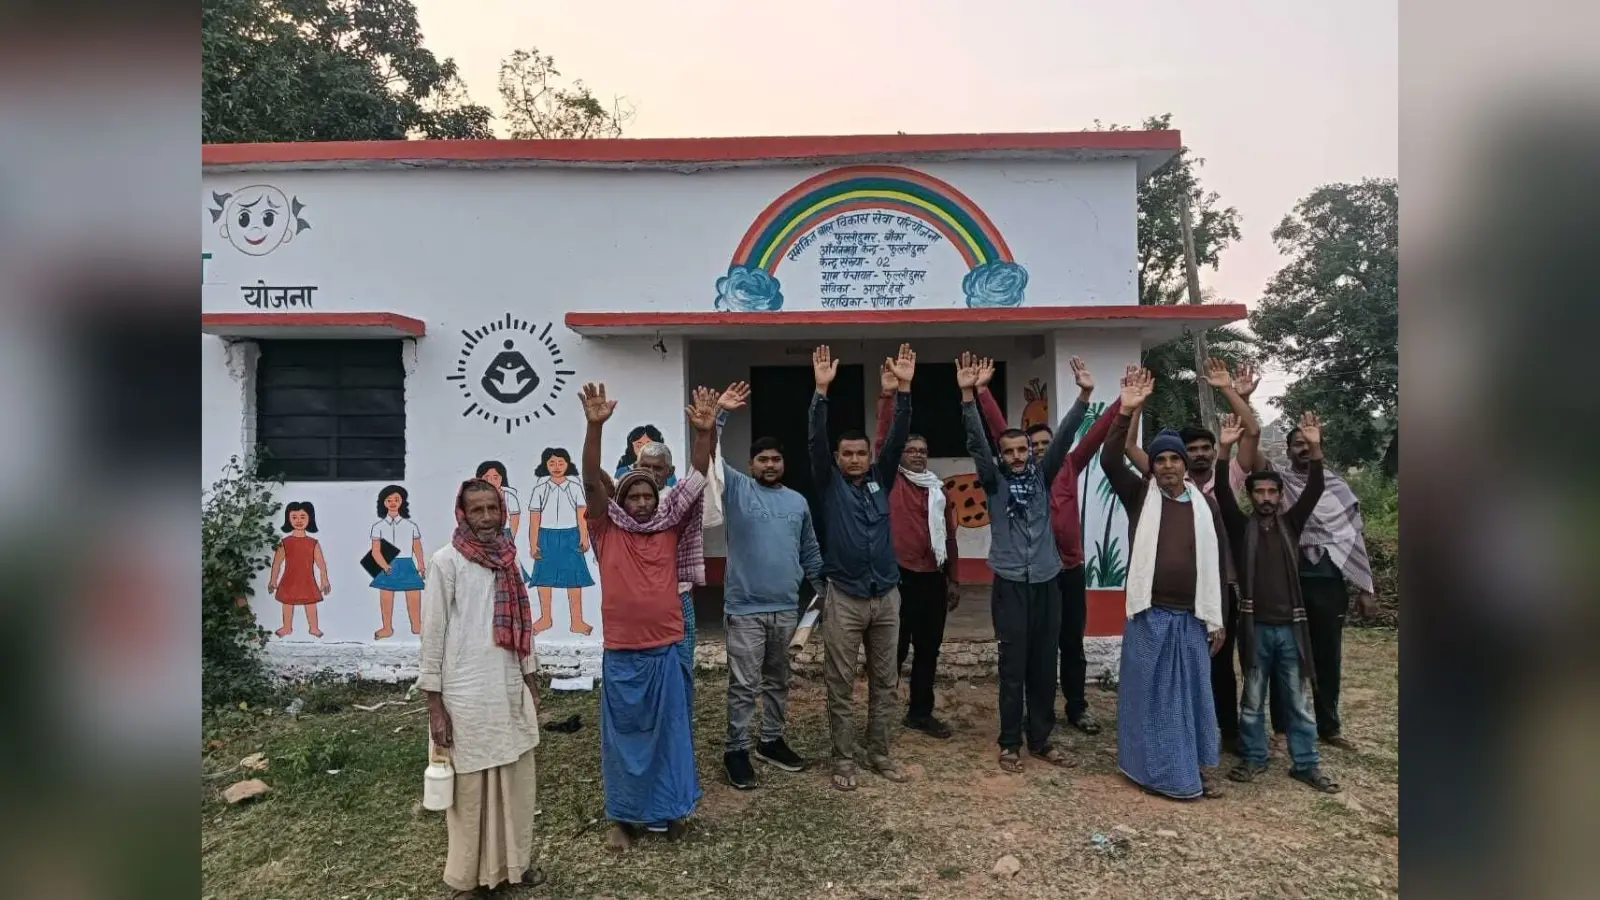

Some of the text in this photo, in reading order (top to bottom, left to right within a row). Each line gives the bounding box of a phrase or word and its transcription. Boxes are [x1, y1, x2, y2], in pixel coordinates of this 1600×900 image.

[836, 213, 870, 227] विकास
[872, 210, 895, 224] सेवा
[897, 216, 942, 243] परियोजना
[876, 257, 890, 267] 02
[821, 271, 840, 282] ग्राम
[241, 279, 318, 309] योजना
